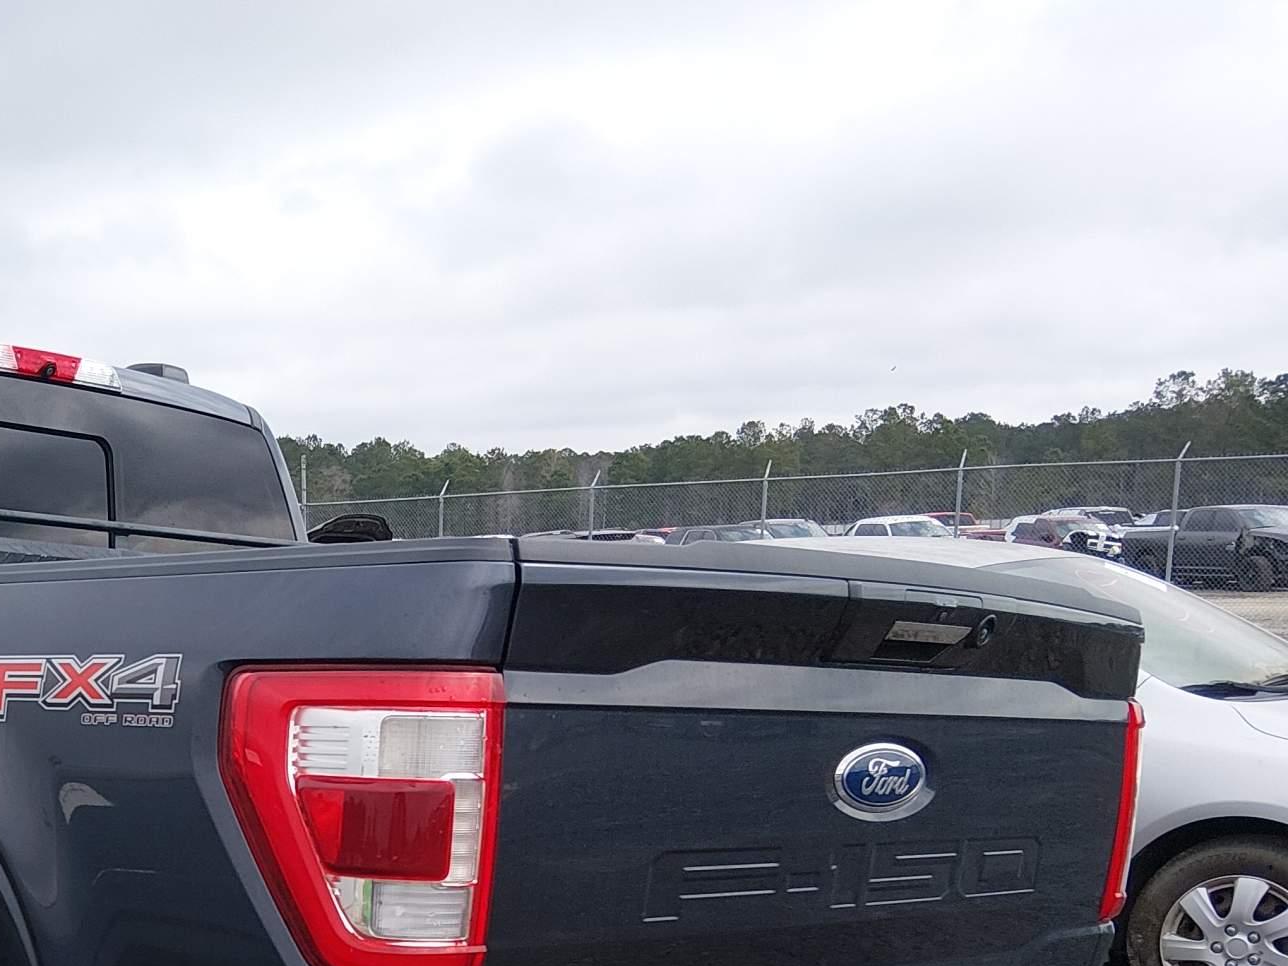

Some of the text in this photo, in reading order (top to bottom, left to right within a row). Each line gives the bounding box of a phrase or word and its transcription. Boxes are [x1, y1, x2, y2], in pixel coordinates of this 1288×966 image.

[81, 713, 174, 727] OFF ROAD
[861, 758, 911, 796] Ford
[643, 837, 1040, 922] F-150
